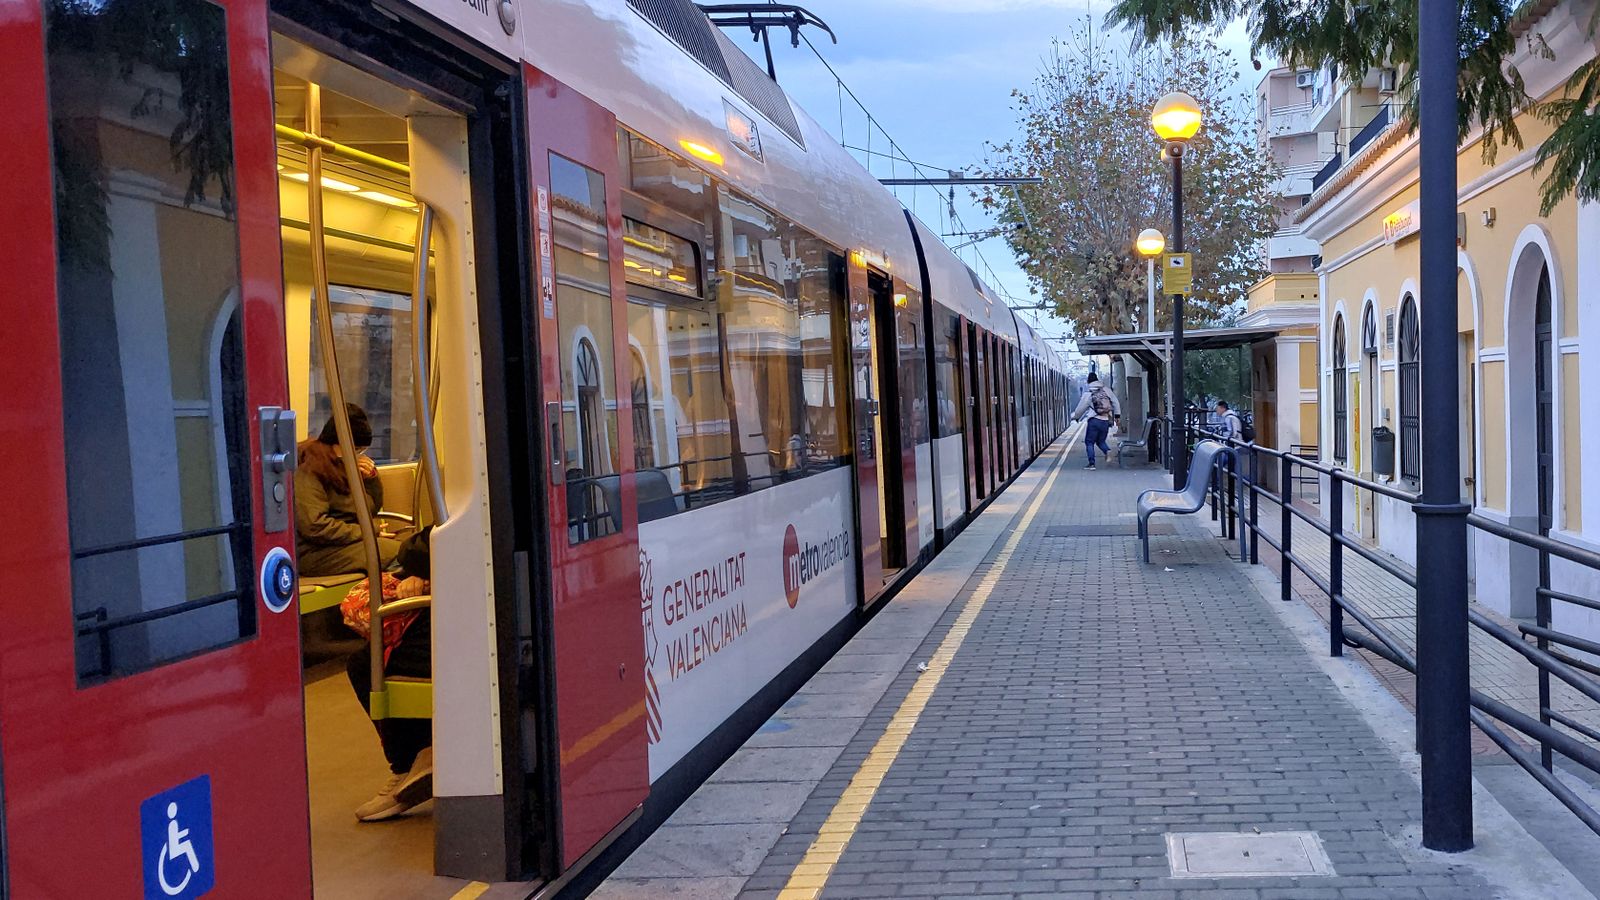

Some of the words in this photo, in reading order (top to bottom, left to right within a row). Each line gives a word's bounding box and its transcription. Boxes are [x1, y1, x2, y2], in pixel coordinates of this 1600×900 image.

[662, 551, 746, 626] GENERALITAT
[789, 522, 850, 592] metrovalencia
[666, 600, 748, 682] VALENCIANA
